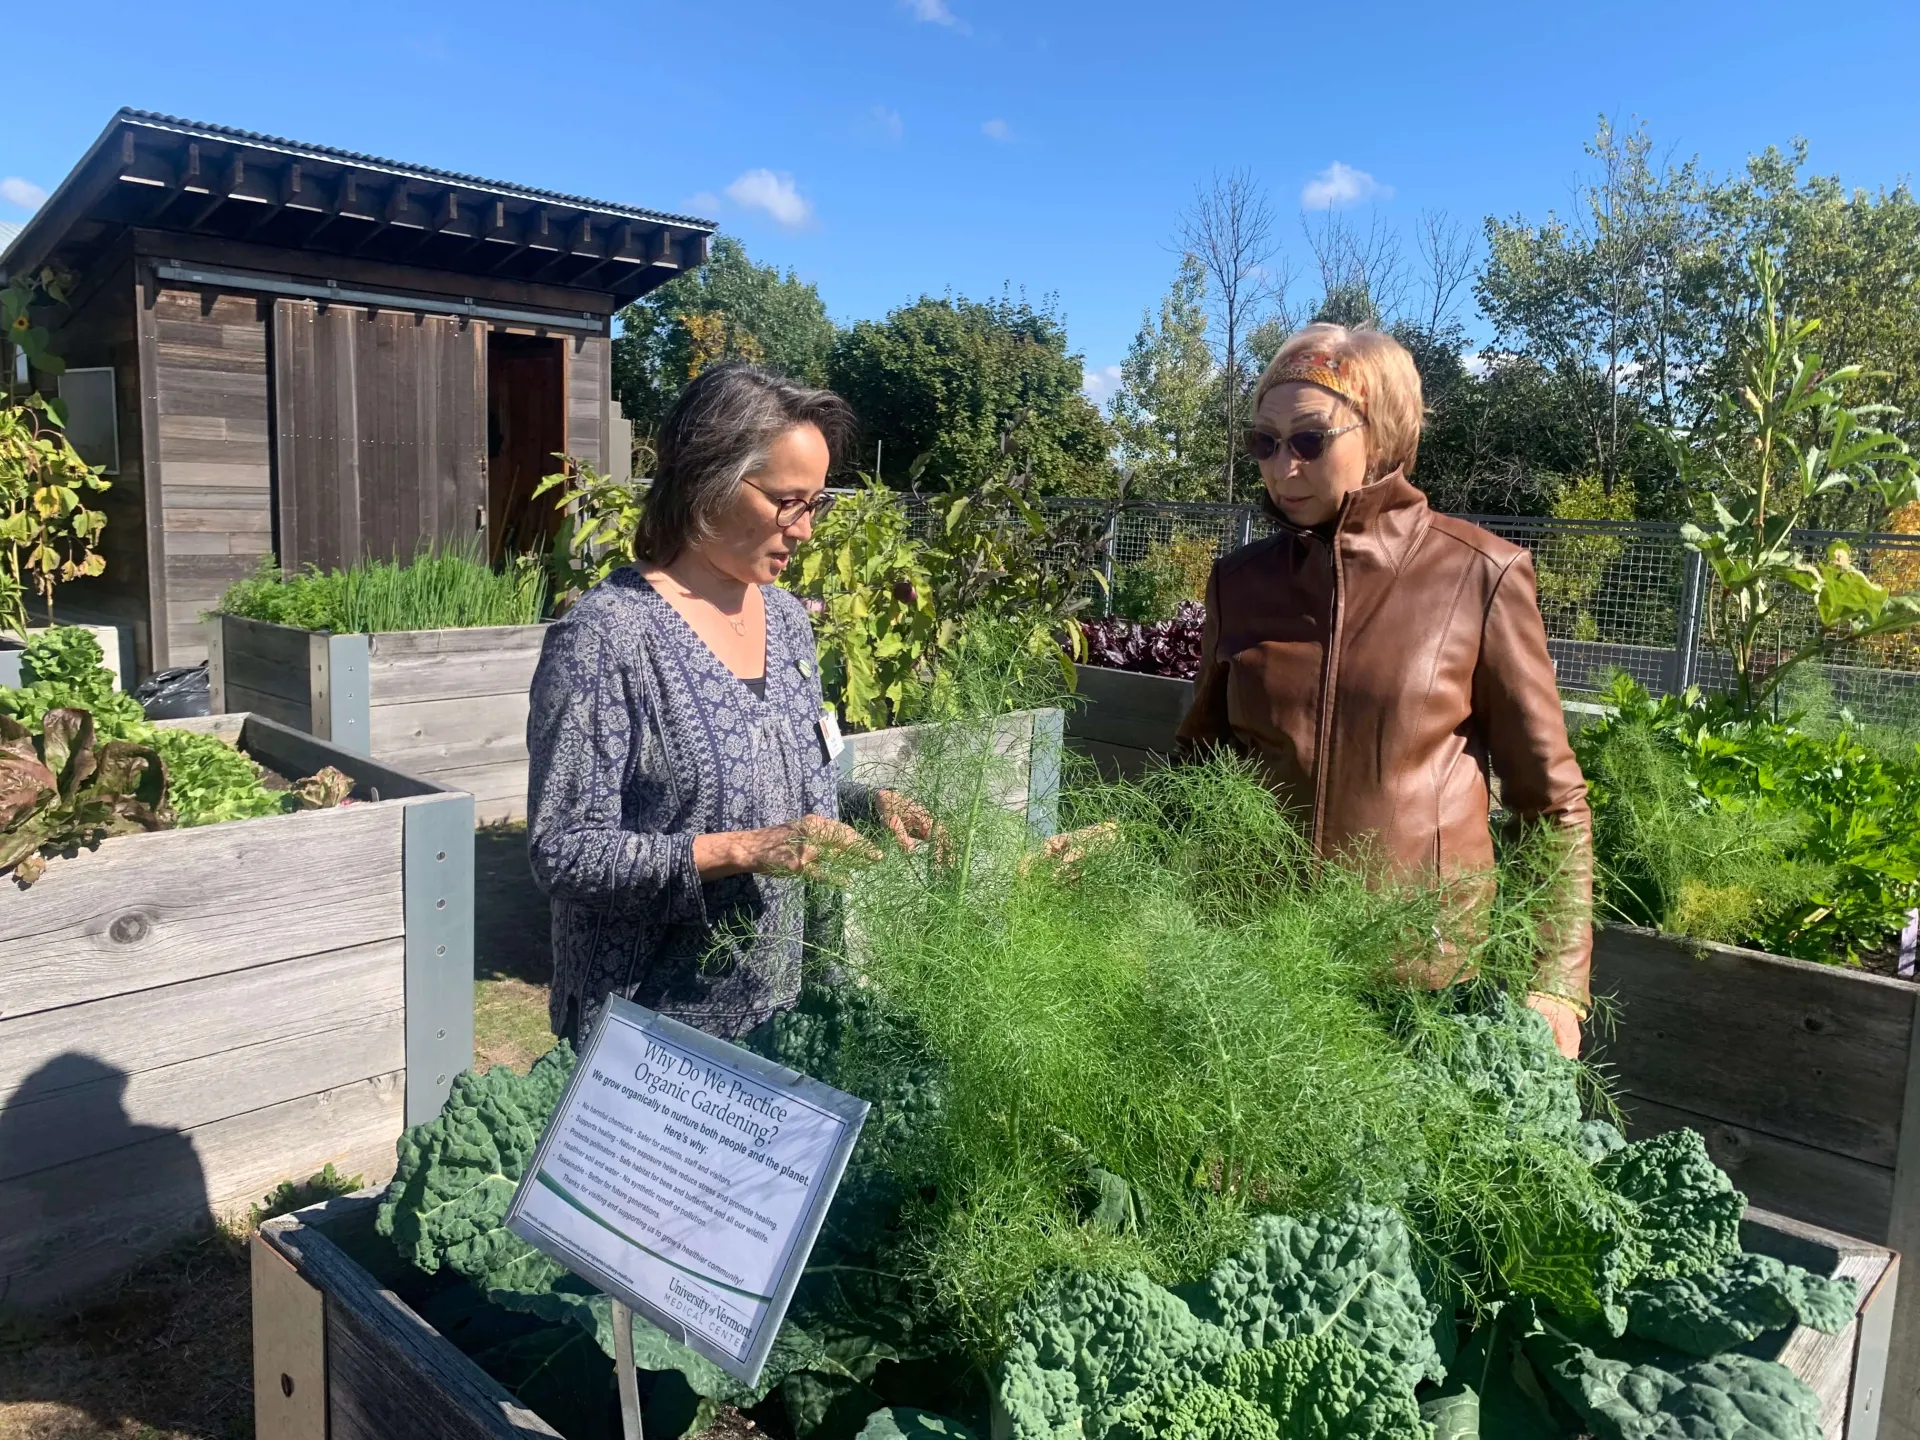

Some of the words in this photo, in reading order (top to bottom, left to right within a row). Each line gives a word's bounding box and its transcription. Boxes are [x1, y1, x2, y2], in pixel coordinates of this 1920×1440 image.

[635, 1063, 690, 1103] Organic
[691, 1090, 779, 1147] Gardening?
[643, 1040, 677, 1075] Why
[677, 1057, 700, 1081] Do
[704, 1068, 726, 1094] We
[727, 1080, 787, 1123] Practice
[582, 1102, 589, 1110] No
[590, 1106, 609, 1120] harmful
[608, 1117, 634, 1134] chemicals
[637, 1131, 652, 1143] Safer
[652, 1139, 660, 1147] for
[659, 1145, 683, 1161] patients,
[684, 1157, 699, 1168] staff
[697, 1164, 710, 1174] and
[710, 1171, 732, 1188] visitors.
[592, 1069, 603, 1081] We
[602, 1077, 622, 1090] grow
[621, 1086, 661, 1113] organically
[661, 1105, 670, 1115] to
[670, 1111, 699, 1130] nurture
[700, 1123, 718, 1140] both
[718, 1135, 747, 1154] people
[748, 1150, 766, 1163] and
[765, 1157, 779, 1171] the
[779, 1166, 809, 1187] planet.
[663, 1124, 688, 1144] Here's
[690, 1139, 709, 1155] why:
[557, 1153, 585, 1175] Sustainable
[588, 1171, 604, 1185] Better
[603, 1180, 612, 1190] for
[612, 1185, 627, 1200] future
[627, 1196, 660, 1219] generations.
[563, 1140, 585, 1157] Healthier
[585, 1154, 595, 1163] soil
[594, 1160, 605, 1169] and
[605, 1166, 620, 1176] water
[622, 1174, 631, 1184] No
[630, 1181, 655, 1198] synthetic
[656, 1194, 674, 1207] runoff
[680, 1208, 706, 1227] pollution.
[570, 1127, 589, 1143] Protects
[589, 1140, 616, 1158] pollinators
[619, 1155, 631, 1167] Safe
[632, 1162, 651, 1178] habitat
[650, 1172, 660, 1181] for
[659, 1178, 673, 1190] bees
[673, 1187, 685, 1196] and
[685, 1191, 714, 1213] butterflies
[714, 1209, 727, 1219] and
[726, 1216, 735, 1224] all
[734, 1221, 746, 1230] our
[746, 1227, 768, 1244] wildlife.
[576, 1114, 597, 1131] Supports
[597, 1127, 616, 1143] healing
[619, 1138, 637, 1153] Nature
[637, 1149, 662, 1166] exposure
[662, 1162, 678, 1175] helps
[678, 1172, 698, 1186] reduce
[698, 1183, 716, 1196] stress
[716, 1193, 729, 1203] and
[728, 1199, 754, 1217] promote
[754, 1211, 777, 1231] healing.
[563, 1173, 580, 1189] Thanks
[580, 1184, 589, 1193] for
[588, 1190, 608, 1206] visiting
[607, 1202, 619, 1211] and
[618, 1208, 648, 1230] supporting
[661, 1234, 677, 1247] grow
[681, 1245, 708, 1264] healthier
[707, 1261, 745, 1285] community!
[664, 1293, 703, 1325] MEDICAL
[709, 1322, 747, 1352] CENTER
[669, 1277, 711, 1315] University
[709, 1308, 717, 1316] of
[716, 1305, 753, 1339] Vermont
